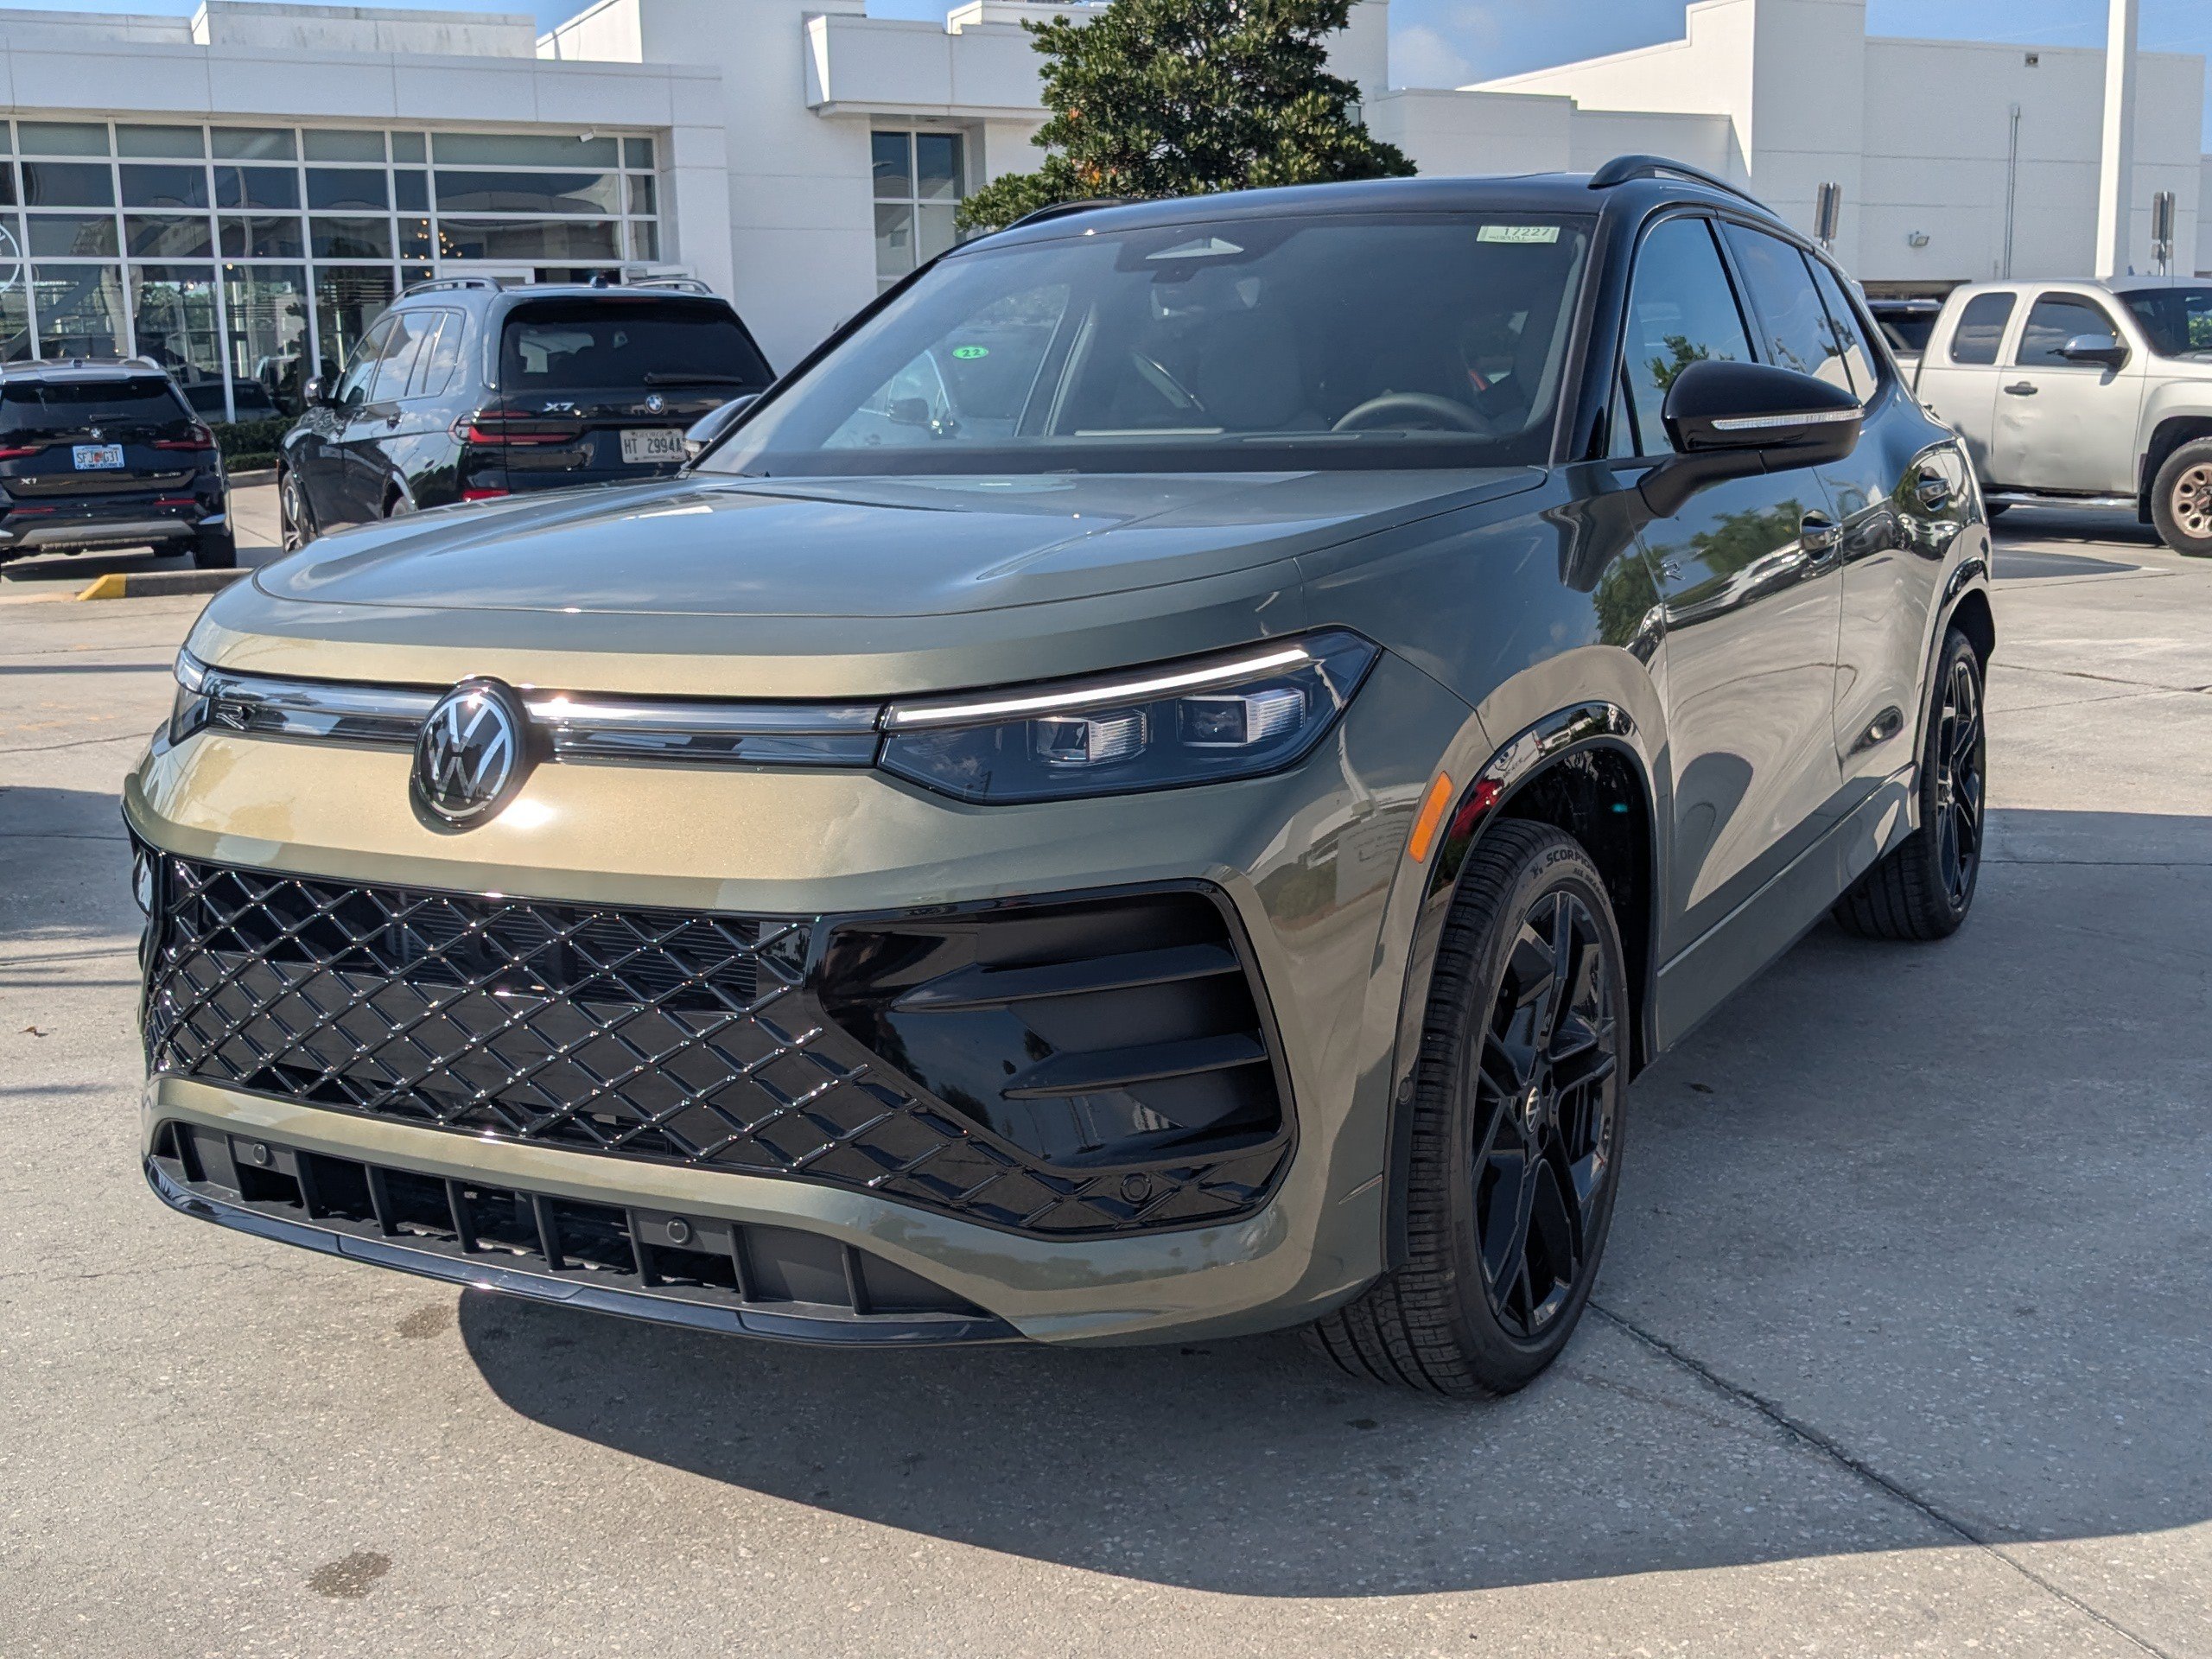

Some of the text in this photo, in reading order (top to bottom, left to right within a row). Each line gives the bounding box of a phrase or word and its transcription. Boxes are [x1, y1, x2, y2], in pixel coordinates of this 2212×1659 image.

[1504, 227, 1550, 237] 17227
[962, 347, 981, 358] 22
[543, 402, 575, 412] X7
[624, 438, 637, 454] HT
